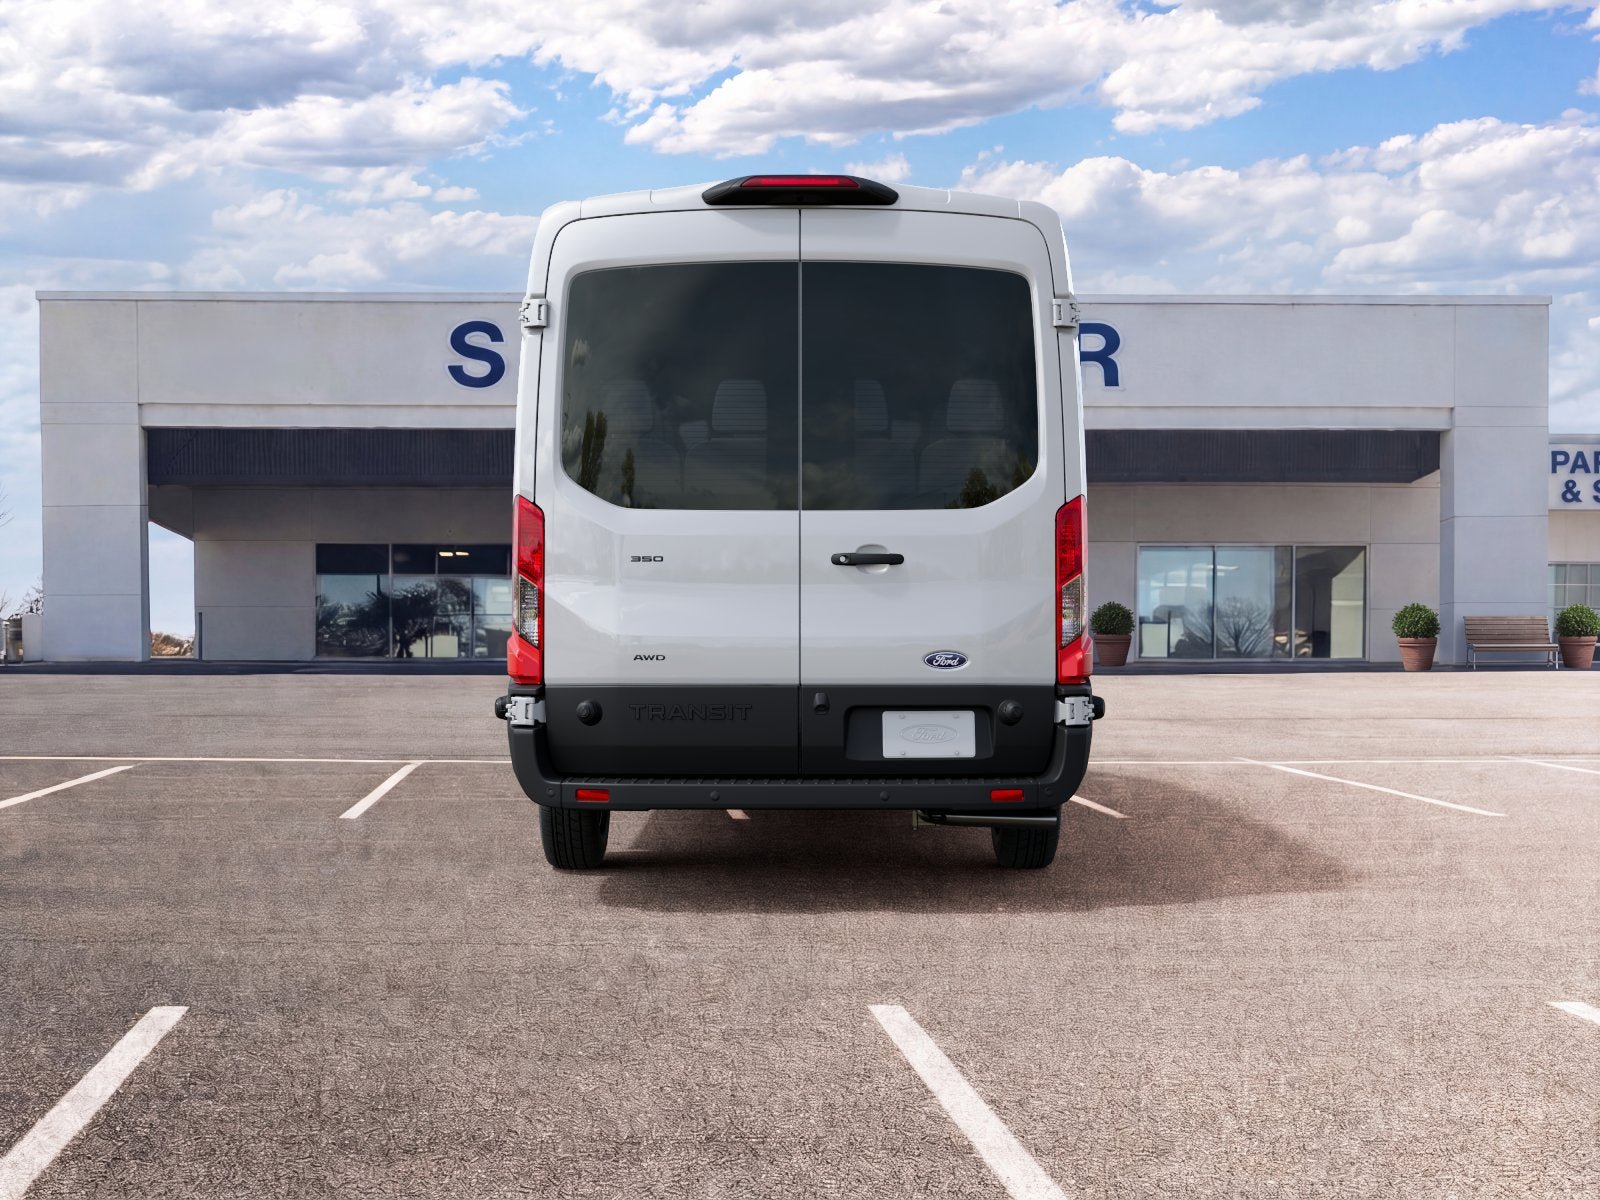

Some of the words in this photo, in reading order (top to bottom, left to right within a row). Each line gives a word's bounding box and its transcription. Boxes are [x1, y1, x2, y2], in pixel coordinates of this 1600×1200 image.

[1551, 450, 1600, 474] PA
[630, 555, 664, 563] 350
[932, 653, 959, 666] Ford
[630, 704, 752, 720] TRANSIT
